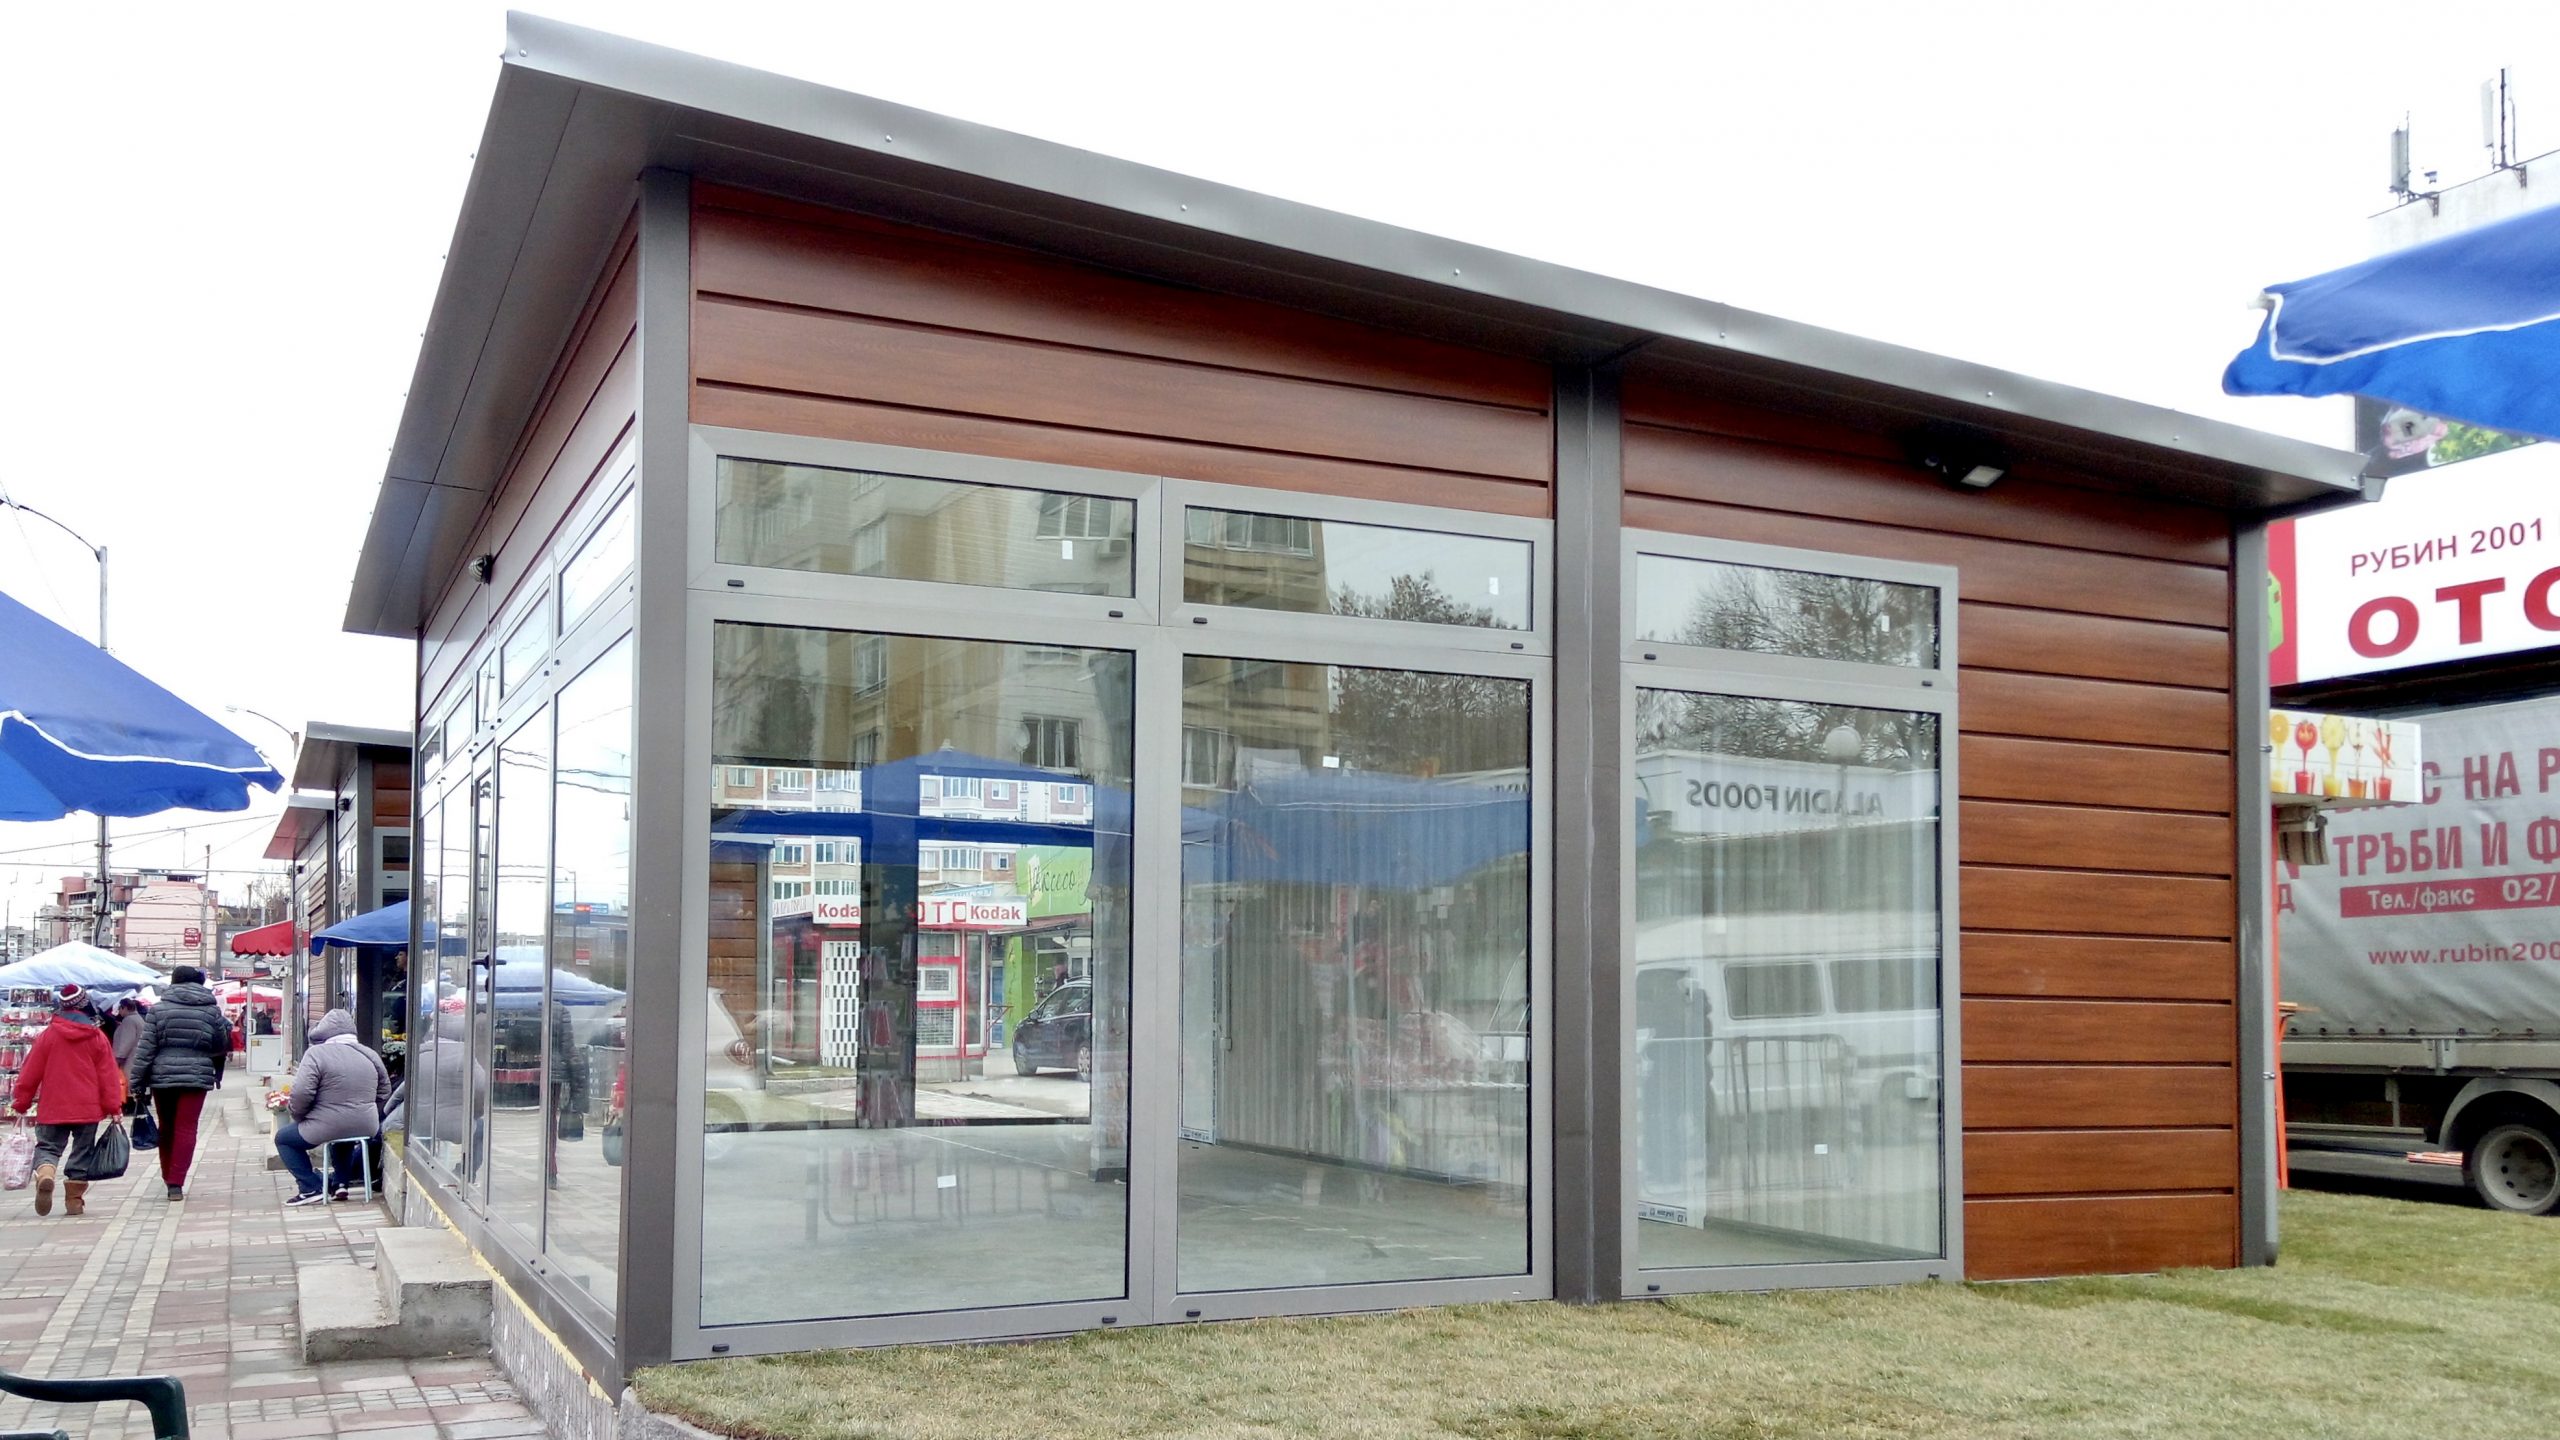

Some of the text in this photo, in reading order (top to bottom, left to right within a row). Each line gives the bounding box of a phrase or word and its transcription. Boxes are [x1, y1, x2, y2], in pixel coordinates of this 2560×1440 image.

[2350, 517, 2542, 577] РУБИН 2001
[2464, 751, 2522, 801] НА
[2332, 825, 2464, 878] ТРЪБИ
[2480, 821, 2509, 867] И
[818, 903, 861, 918] Koda
[970, 904, 1021, 921] Kodak
[2367, 886, 2476, 912] Тел./факс
